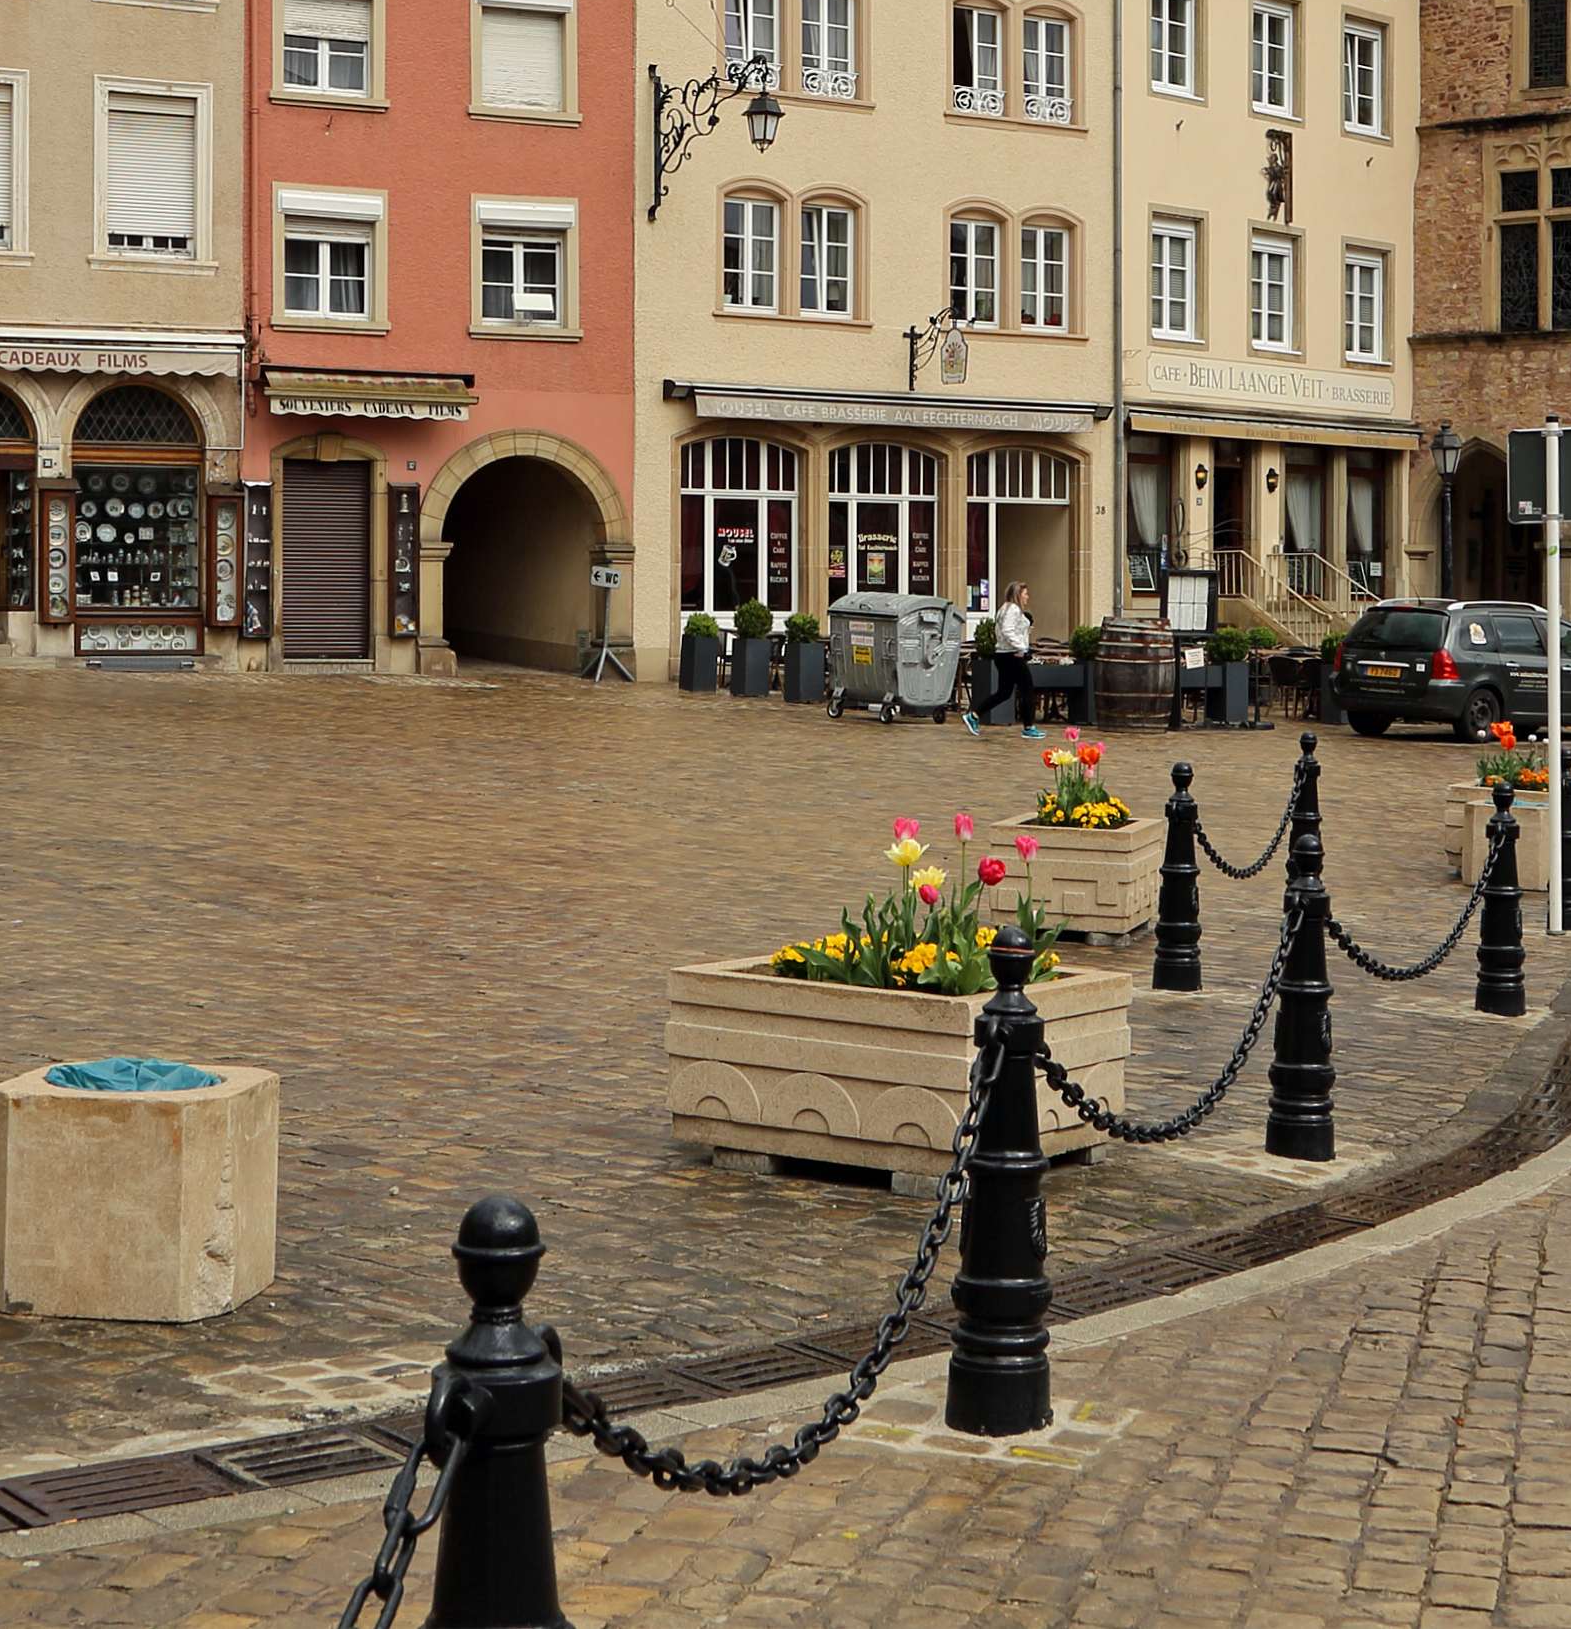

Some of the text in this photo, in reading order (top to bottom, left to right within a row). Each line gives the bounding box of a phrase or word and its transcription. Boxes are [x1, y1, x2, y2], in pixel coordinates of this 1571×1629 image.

[97, 353, 148, 368] FILMS
[1153, 362, 1391, 405] CAFE BEIM LAANGE VEIT BRASSERIE
[279, 399, 462, 417] SOUVENIERS CADEAUX FILMS
[783, 404, 816, 418] CAFE
[822, 407, 887, 421] BRASSERIE
[894, 410, 918, 423] AAL
[923, 411, 1018, 427] EECHTERNOACH
[1245, 428, 1282, 440] BRASSERIE
[605, 572, 619, 585] WC
